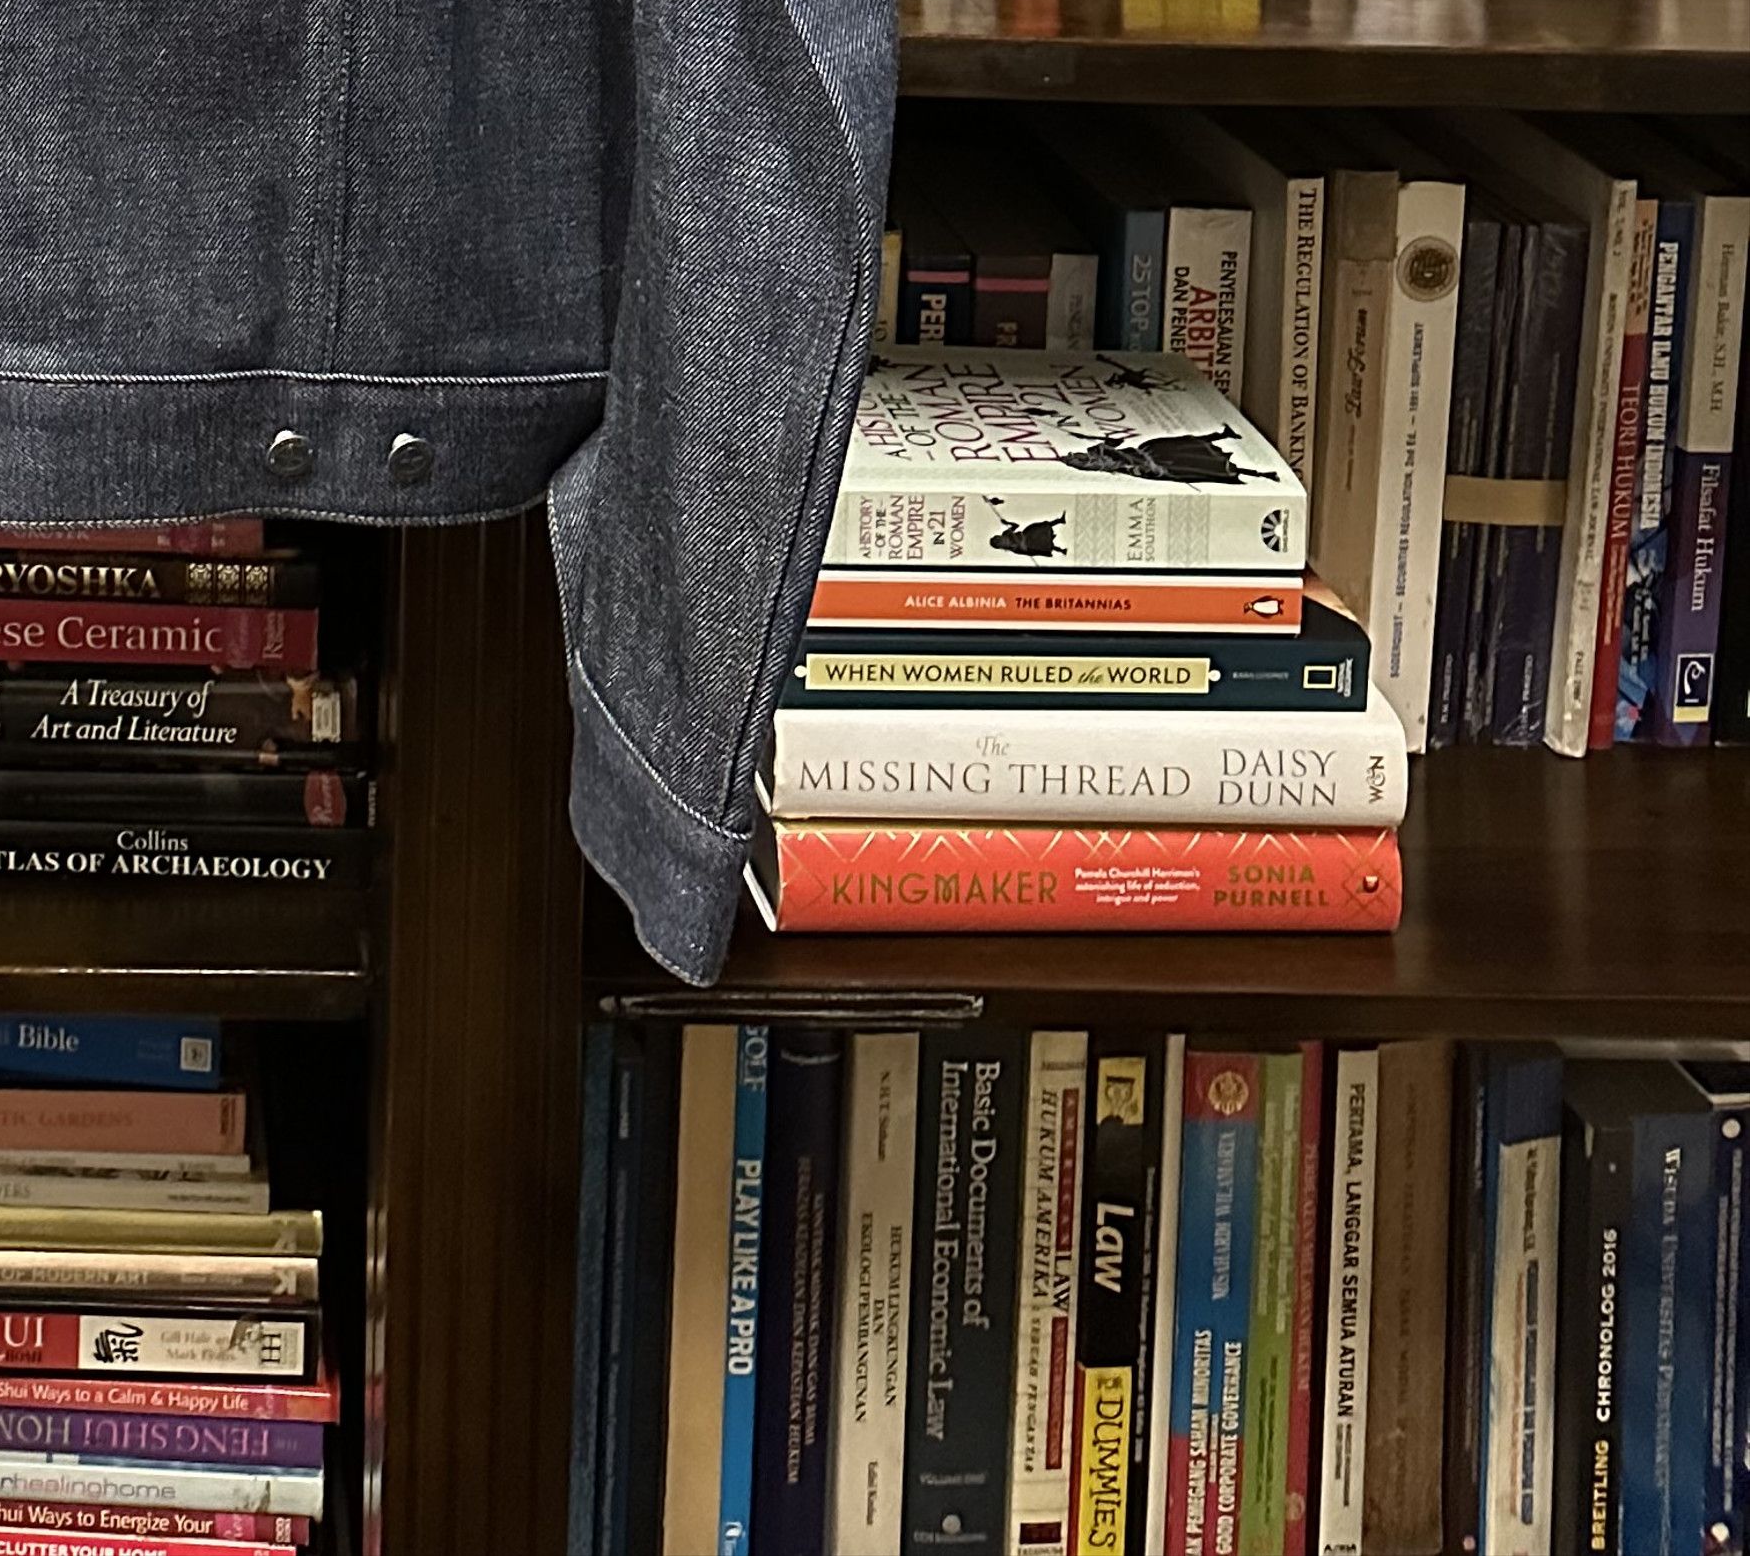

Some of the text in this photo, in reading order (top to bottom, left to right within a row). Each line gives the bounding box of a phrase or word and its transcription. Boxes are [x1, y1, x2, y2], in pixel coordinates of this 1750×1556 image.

[825, 664, 1191, 686] WHEN WOMEN RULED the WORLD
[1221, 749, 1337, 777] DAISY
[798, 760, 1191, 798] MISSING THREAD
[1217, 779, 1337, 807] DUNN
[117, 829, 189, 851] Collins
[67, 853, 105, 874] OF
[110, 853, 333, 881] ARCHAEOLOGY
[832, 873, 1058, 905] KINGMAKER
[1095, 1201, 1135, 1293] Law
[1591, 1228, 1618, 1550] BREITLING CHRONOLOG 2016
[1089, 1397, 1124, 1549] DUMMIES
